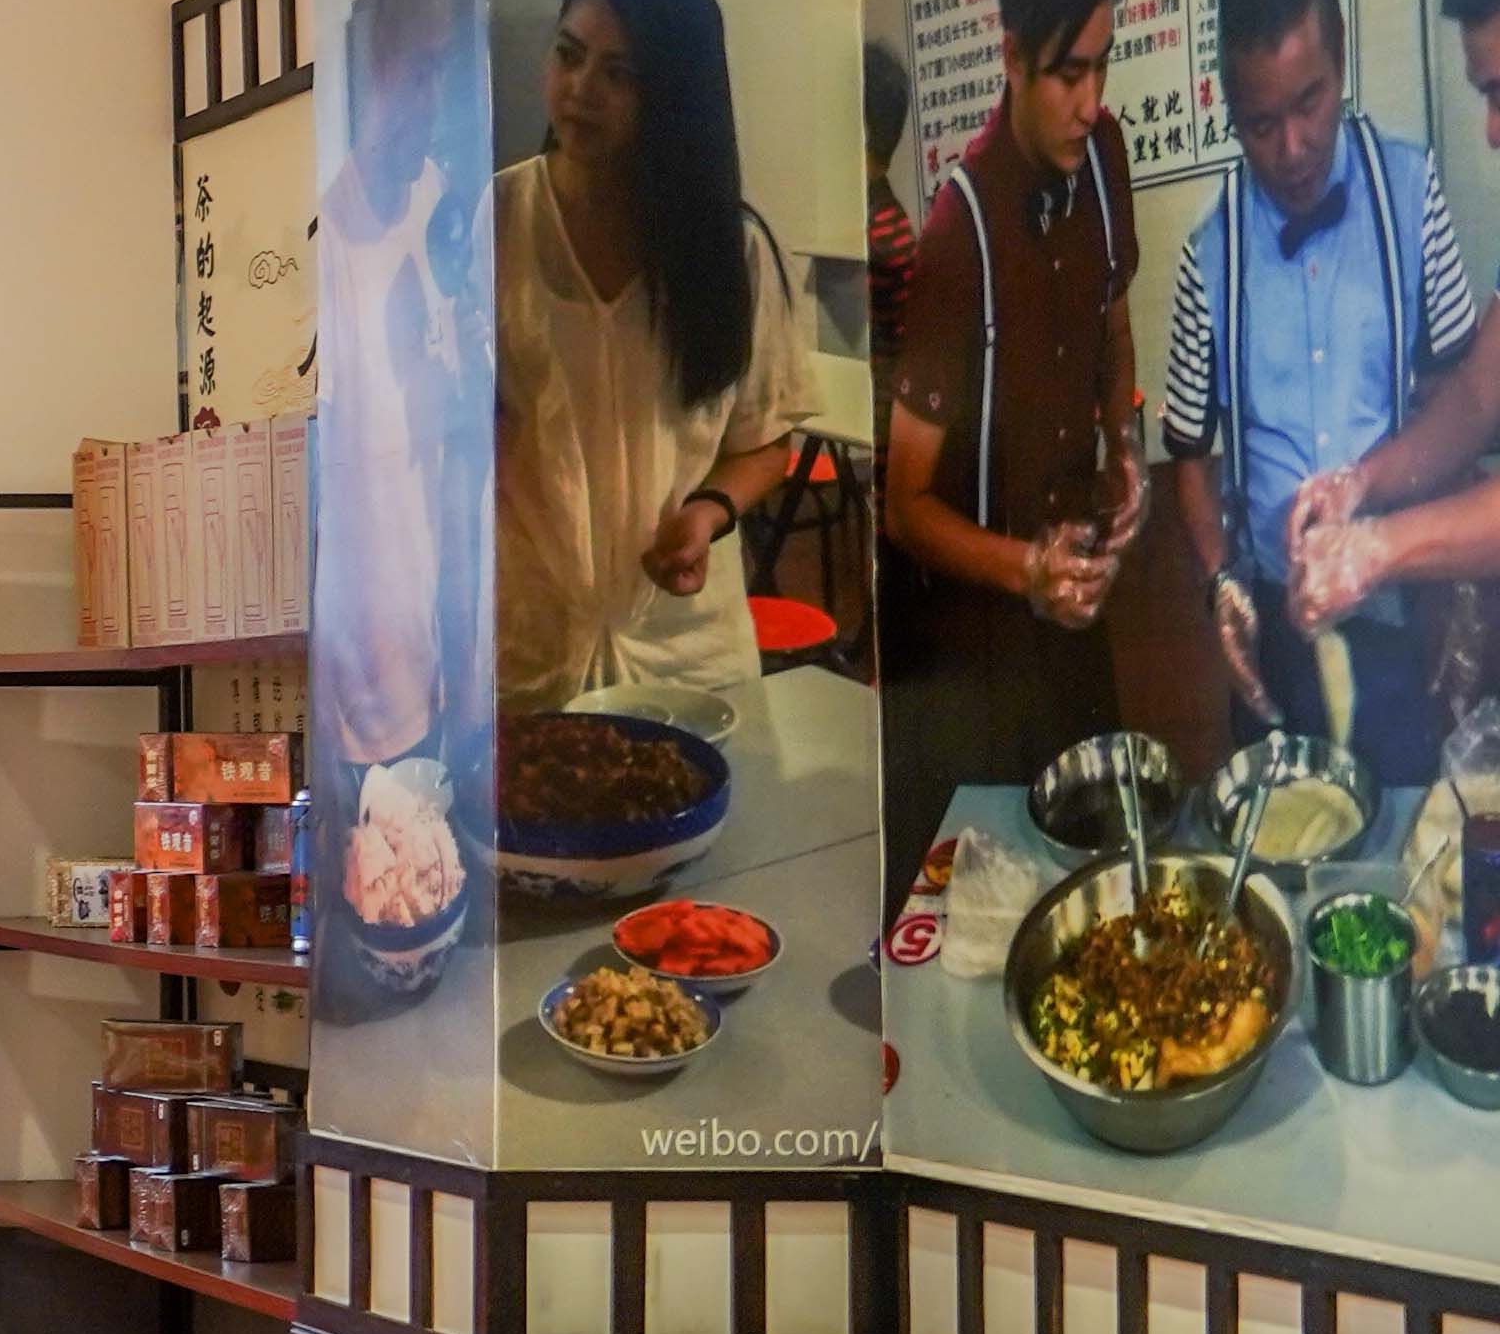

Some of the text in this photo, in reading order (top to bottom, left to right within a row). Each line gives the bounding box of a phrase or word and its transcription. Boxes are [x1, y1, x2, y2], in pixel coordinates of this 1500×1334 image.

[195, 174, 216, 396] 茶的起源
[221, 760, 272, 782] 铁观音
[160, 831, 193, 854] 铁观音
[641, 1118, 878, 1163] weibo.com/
